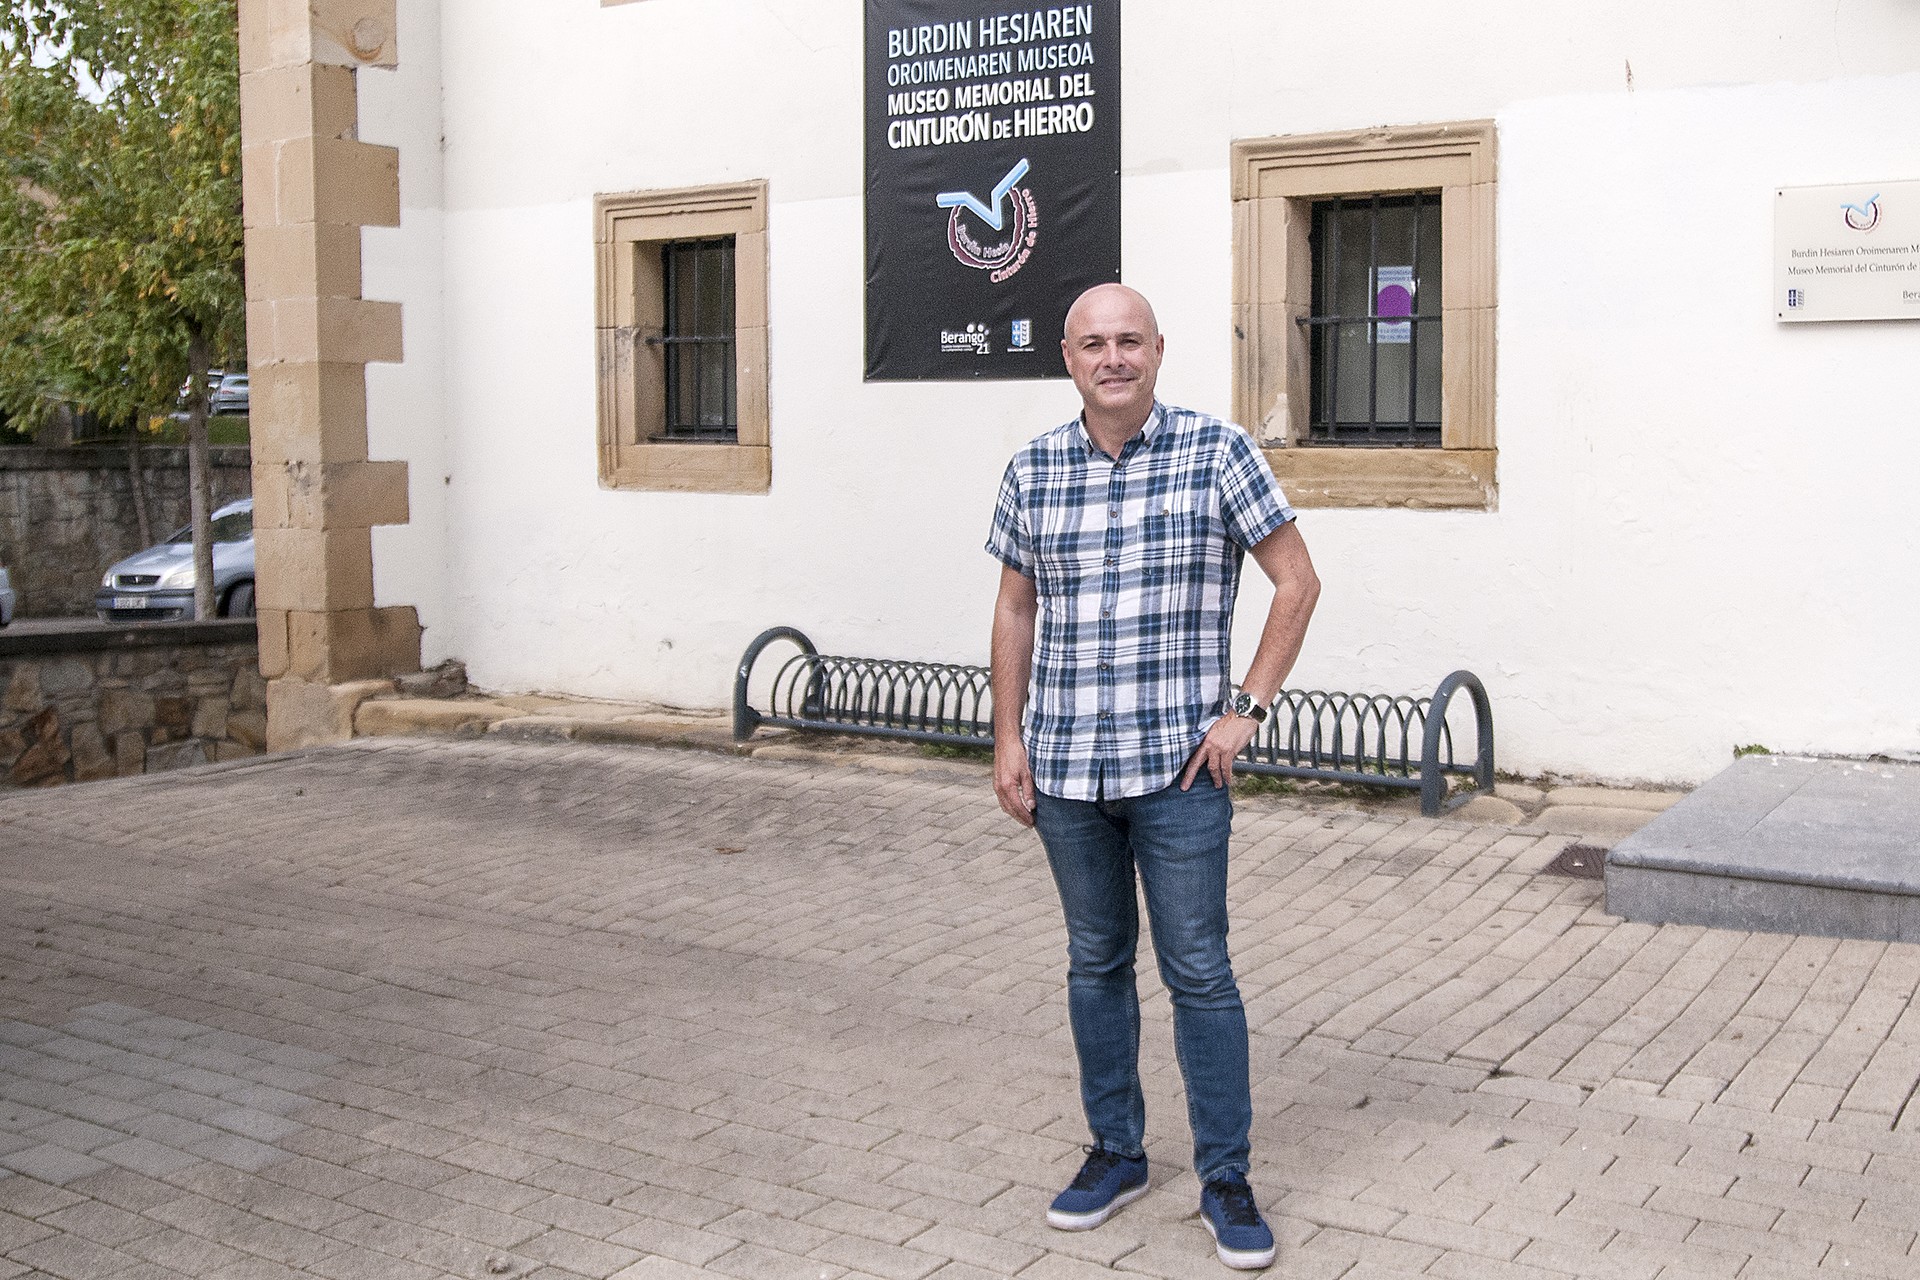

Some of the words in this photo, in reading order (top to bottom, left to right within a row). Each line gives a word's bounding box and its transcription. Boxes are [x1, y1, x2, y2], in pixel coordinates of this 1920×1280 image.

[888, 20, 972, 58] BURDIN
[979, 5, 1093, 47] HESIAREN
[887, 51, 1012, 87] OROIMENAREN
[1017, 42, 1094, 72] MUSEOA
[887, 88, 949, 116] MUSEO
[955, 77, 1055, 110] MEMORIAL
[1059, 73, 1096, 99] DEL
[887, 110, 991, 150] CINTURÓN
[992, 119, 1012, 140] DE
[1014, 102, 1094, 138] HIERRO
[1791, 249, 1818, 258] Burdin
[1820, 247, 1854, 257] Hesiaren
[1856, 246, 1909, 256] Oroimenaren
[1788, 266, 1814, 275] Museo
[1815, 264, 1853, 274] Memorial
[1855, 263, 1867, 273] del
[1869, 262, 1905, 272] Cinturón
[1907, 261, 1917, 271] de
[941, 331, 985, 346] Berango
[976, 343, 990, 355] 21
